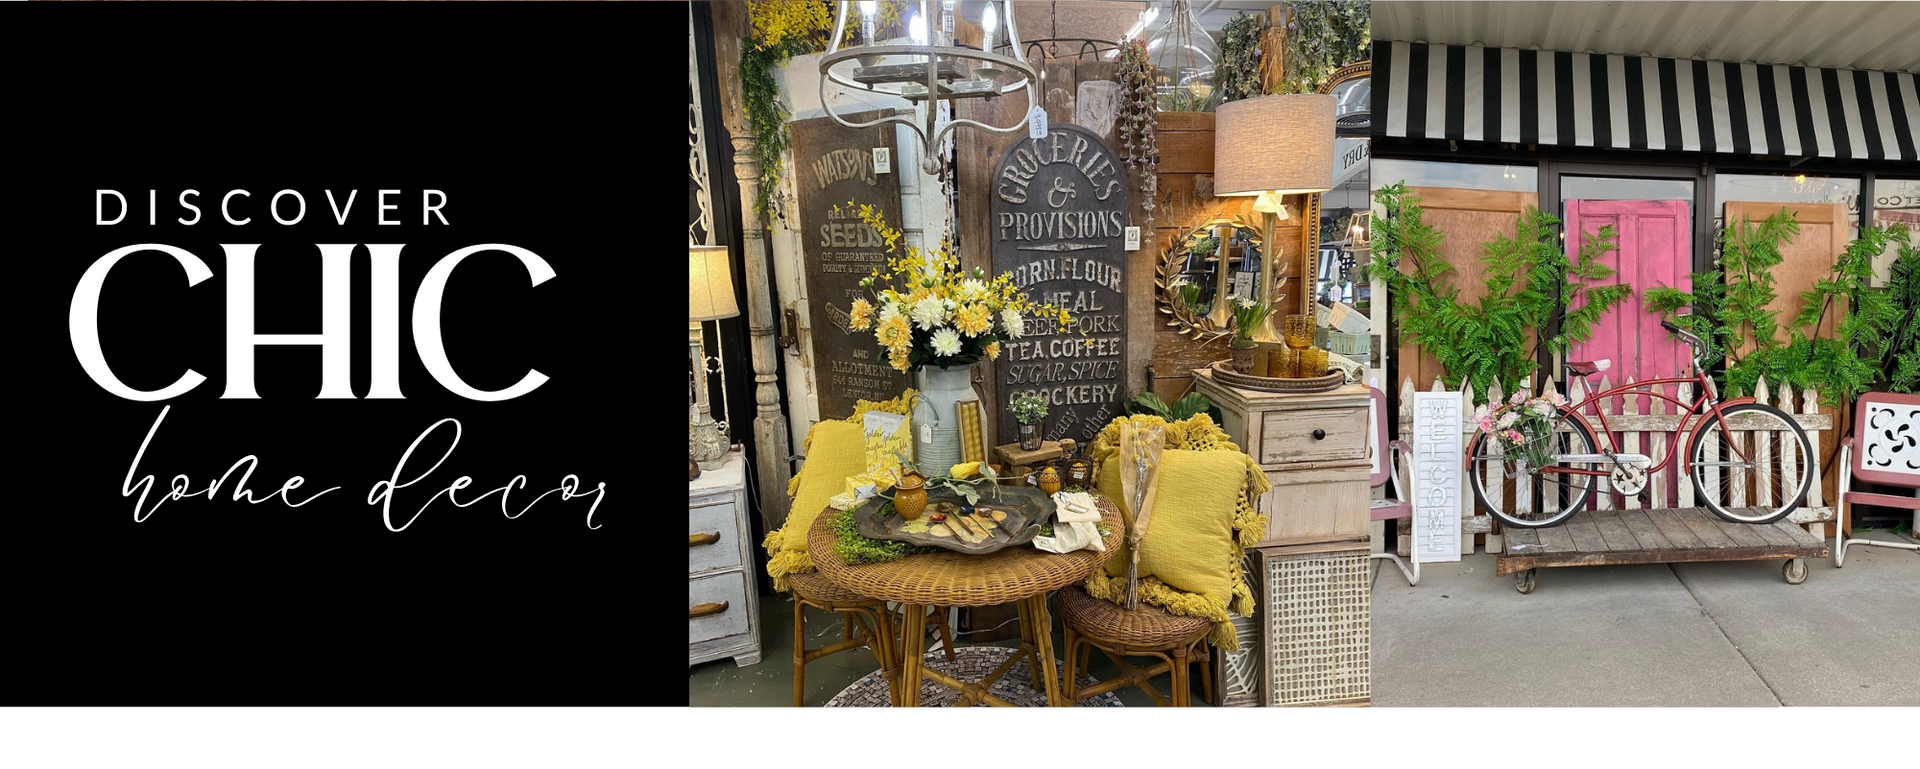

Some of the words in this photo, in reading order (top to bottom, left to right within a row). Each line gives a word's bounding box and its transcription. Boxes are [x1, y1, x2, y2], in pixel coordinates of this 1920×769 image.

[998, 132, 1122, 204] GROCERIES
[1047, 176, 1077, 208] &
[820, 222, 883, 248] SEEDS
[999, 210, 1123, 242] PROVISIONS
[821, 251, 833, 261] OF
[836, 252, 884, 262] GUARANTEED
[823, 263, 847, 273] PURITY
[845, 289, 864, 298] FOR
[1042, 290, 1104, 314] MEAL
[825, 301, 851, 332] GARDE
[1066, 314, 1121, 335] PORK
[853, 350, 869, 359] AND
[831, 360, 893, 378] ALLOTMENT
[848, 376, 880, 390] RANSOM
[882, 380, 896, 391] ST.
[1045, 406, 1080, 442] many
[1081, 403, 1112, 440] other
[1427, 399, 1448, 553] WELCOME
